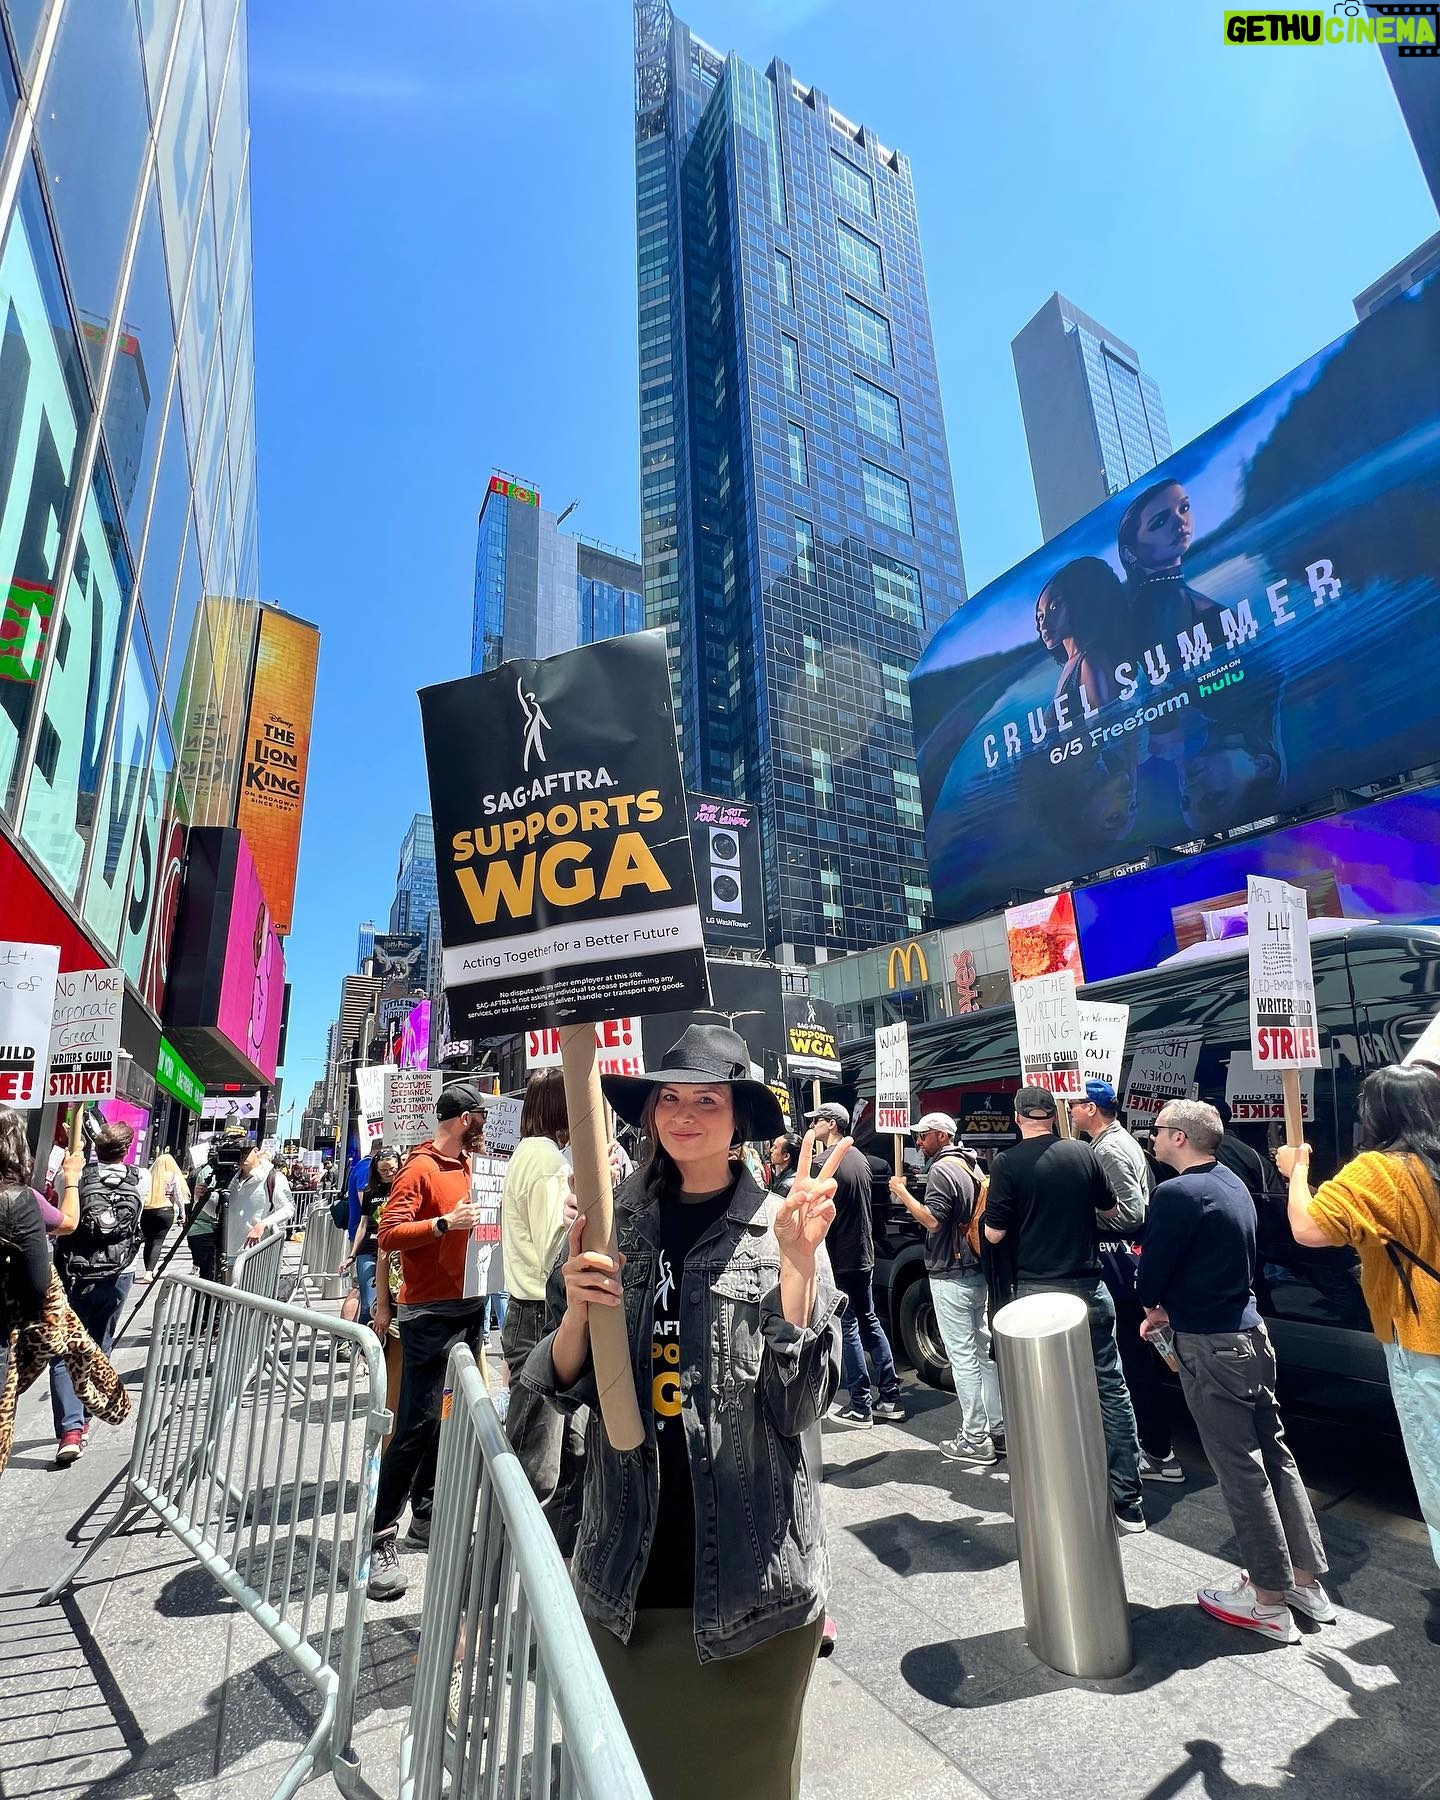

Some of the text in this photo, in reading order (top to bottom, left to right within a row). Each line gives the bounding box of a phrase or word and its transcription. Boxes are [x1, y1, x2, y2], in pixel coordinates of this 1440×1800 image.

[983, 558, 1342, 768] CRUEL SUMMER
[1197, 658, 1241, 683] STREAM ON
[1199, 670, 1245, 697] hulu
[263, 723, 295, 745] THE
[1049, 691, 1189, 766] 6/5 Freeform
[255, 739, 297, 768] LION
[245, 762, 300, 795] KING
[244, 790, 299, 809] ON BROADWAY
[251, 797, 273, 808] SINCE
[452, 789, 664, 862] SUPPORTS
[455, 831, 672, 925] WGA
[705, 916, 715, 924] LG
[463, 925, 680, 970] Acting Together for a Better Future
[510, 988, 535, 998] dispute
[554, 981, 569, 989] other
[570, 976, 604, 986] employer
[605, 974, 612, 982] at
[614, 972, 628, 980] this
[629, 971, 644, 979] site.
[555, 987, 587, 997] individual
[619, 977, 660, 989] performing
[660, 975, 674, 983] any
[1020, 976, 1067, 1003] DO THE
[53, 998, 116, 1021] orporate
[384, 1000, 404, 1010] LITTLE
[509, 1004, 530, 1013] refuse
[577, 991, 602, 1001] handle
[612, 987, 646, 997] transport
[647, 984, 661, 993] any
[1026, 997, 1067, 1023] WRITE
[789, 1028, 835, 1043] SUPPORTS
[1023, 1021, 1074, 1049] THING
[51, 1050, 113, 1064] WRITERS GUILD
[790, 1036, 836, 1058] WGA
[1024, 1050, 1078, 1064] WRITERS GUILD
[72, 1064, 82, 1072] ON
[50, 1070, 112, 1096] STRIKE!
[391, 1081, 432, 1089] COSTUME
[391, 1089, 433, 1097] DESIGNER
[1026, 1070, 1082, 1093] STRIKE!
[394, 1120, 429, 1130] WGA
[496, 1142, 515, 1151] GUILD
